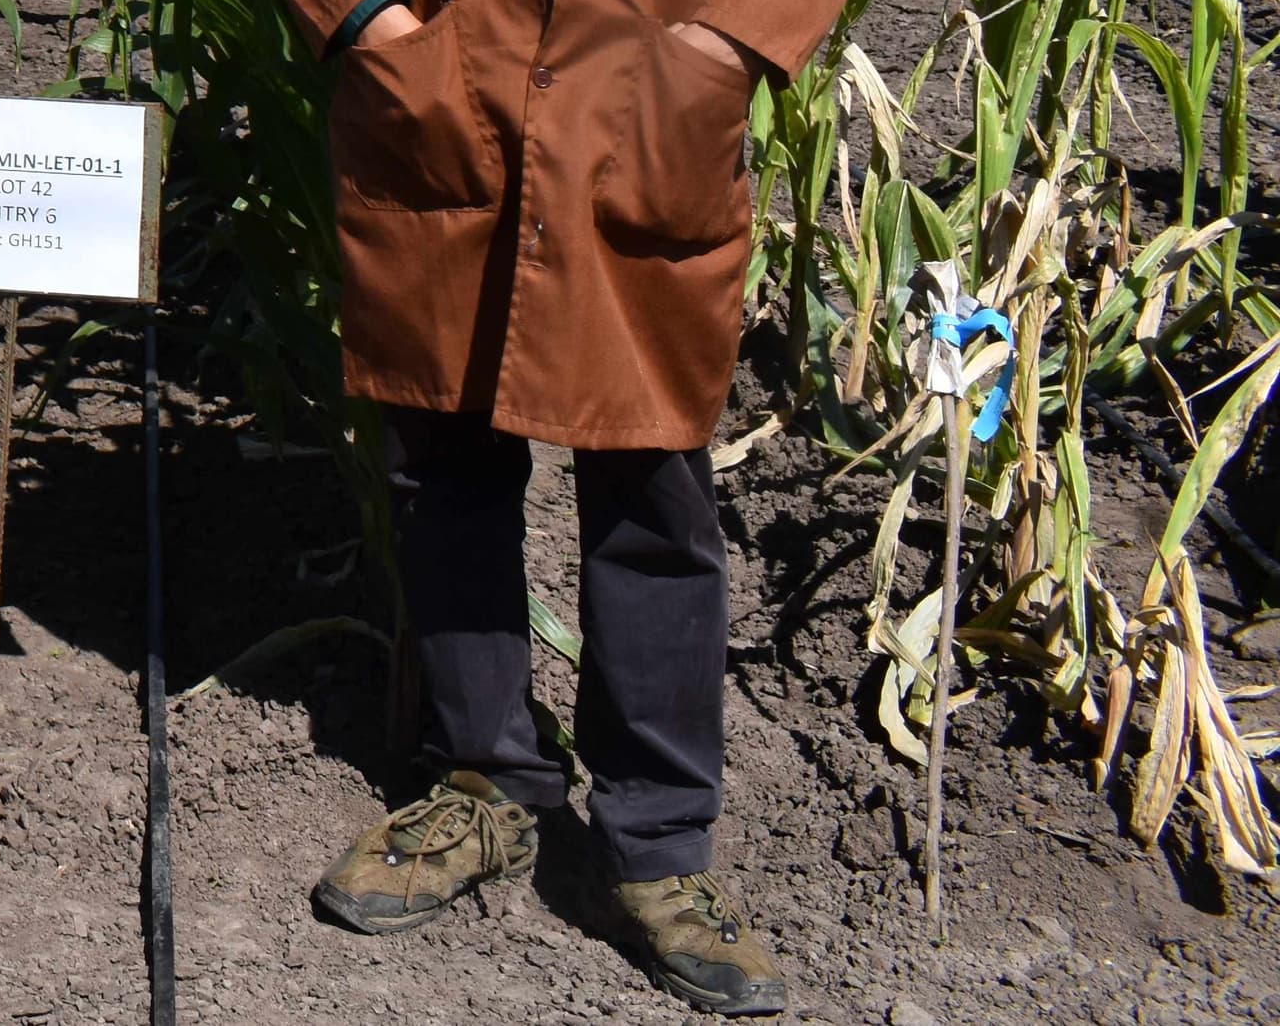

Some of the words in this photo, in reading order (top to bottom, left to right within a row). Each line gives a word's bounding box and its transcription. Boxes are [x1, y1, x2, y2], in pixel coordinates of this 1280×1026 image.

[31, 181, 53, 197] 42
[46, 208, 57, 224] 6
[8, 233, 63, 250] GH151
